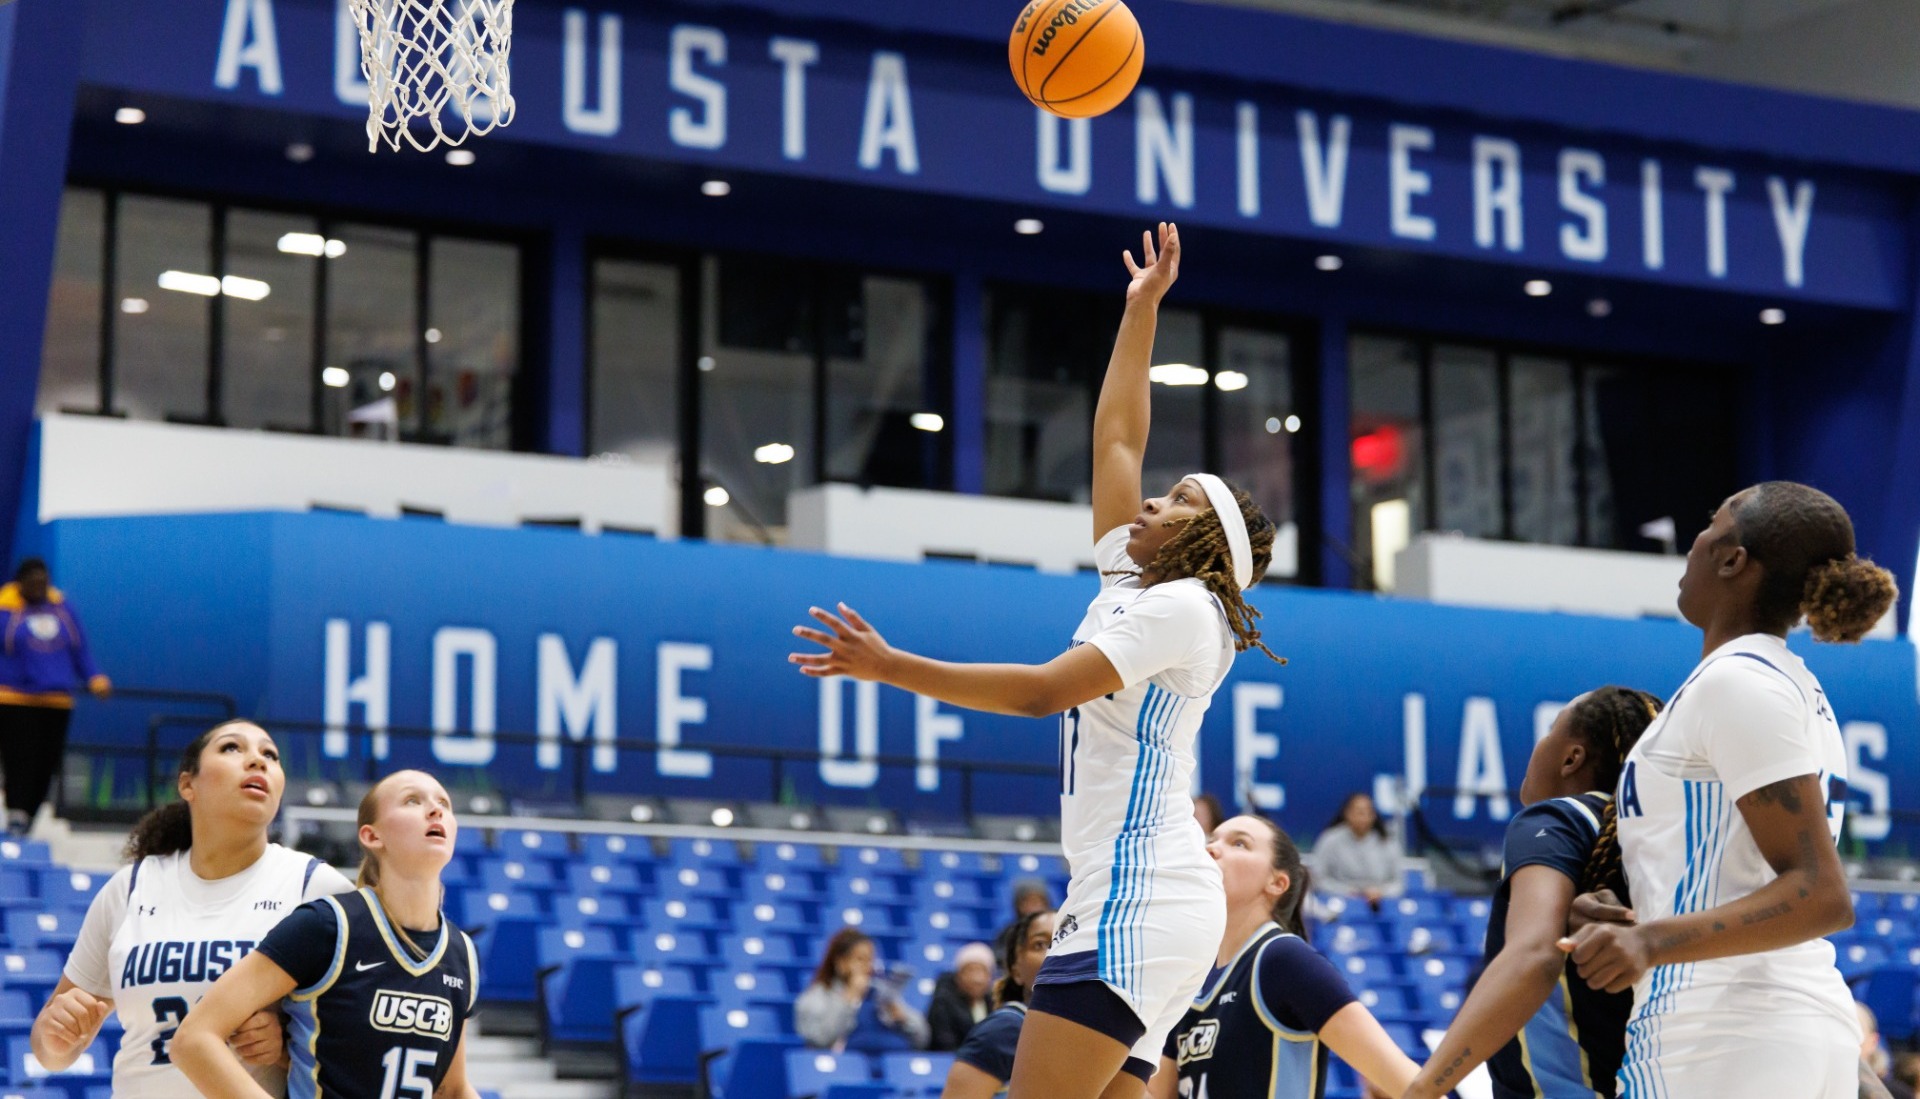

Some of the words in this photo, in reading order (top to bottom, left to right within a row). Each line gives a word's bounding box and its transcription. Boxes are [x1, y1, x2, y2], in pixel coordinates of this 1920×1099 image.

[1037, 87, 1815, 288] UNIVERSITY
[323, 618, 713, 779] HOME
[818, 674, 964, 792] OF
[374, 995, 452, 1034] USCB
[380, 1046, 438, 1099] 15
